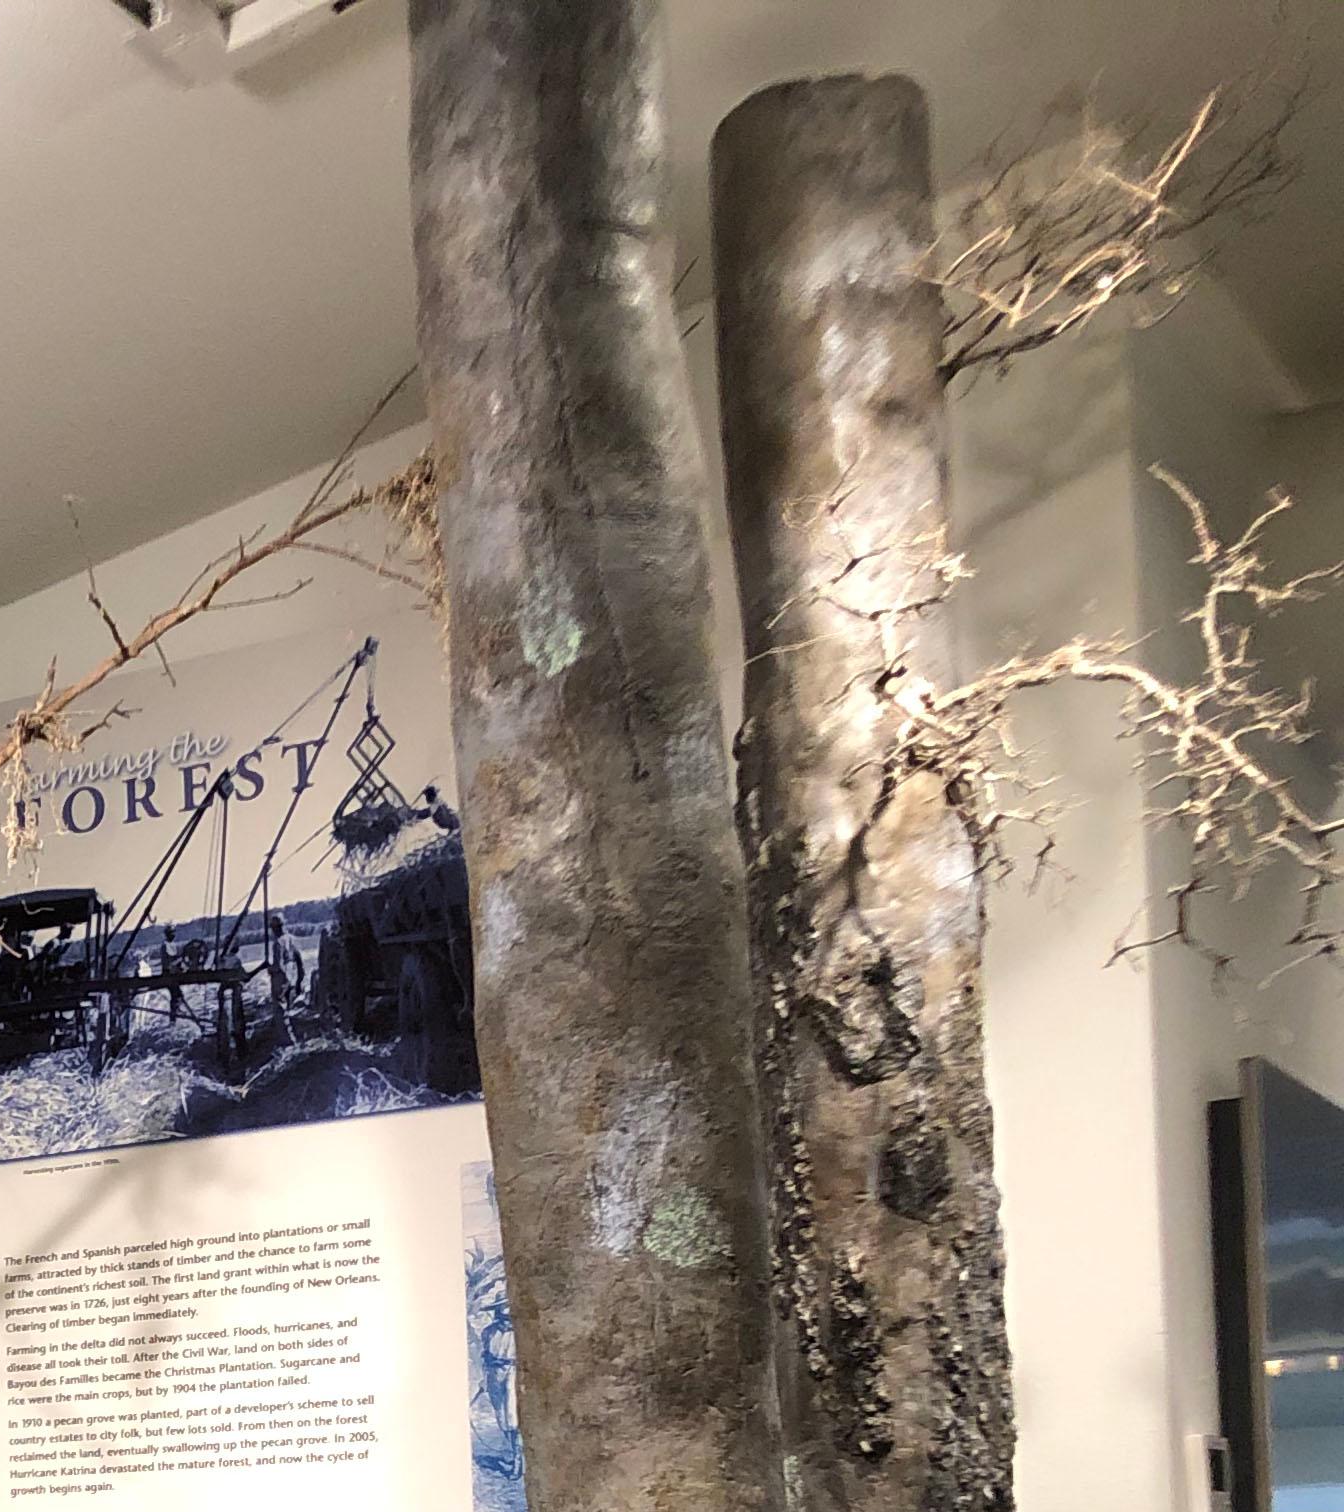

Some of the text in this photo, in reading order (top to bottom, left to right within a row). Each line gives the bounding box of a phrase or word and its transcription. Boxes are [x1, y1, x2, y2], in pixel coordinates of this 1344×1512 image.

[28, 732, 229, 794] arming the
[15, 740, 323, 834] FOREST
[6, 1317, 358, 1356] Farming in the delta did not always succeed. Floods, hurricanes, and
[6, 1363, 42, 1372] disease
[44, 1360, 56, 1369] all
[58, 1358, 81, 1368] took
[83, 1356, 108, 1366] their
[110, 1354, 132, 1363] toll.
[132, 1352, 159, 1362] After
[161, 1350, 179, 1360] the
[181, 1348, 204, 1358] Civil
[206, 1347, 230, 1356] War,
[234, 1344, 258, 1354] land
[277, 1340, 303, 1350] both
[307, 1339, 333, 1348] sides
[336, 1336, 348, 1346] of
[6, 1353, 360, 1390] Bayou des Families became the Christmas Plantation. Sugarcane and
[7, 1375, 309, 1405] rice were the main crops, but by 1904 the plantation failed.
[7, 1420, 18, 1428] In
[21, 1418, 43, 1428] 1910
[53, 1417, 83, 1427] pecan
[85, 1415, 115, 1426] grove
[139, 1409, 182, 1422] planted,
[185, 1408, 207, 1418] part
[210, 1405, 222, 1415] of
[233, 1402, 294, 1413] developer's
[297, 1400, 338, 1409] scheme
[341, 1398, 353, 1406] to
[356, 1395, 374, 1405] sell
[8, 1436, 46, 1445] country
[48, 1434, 84, 1443] estates
[99, 1431, 118, 1441] city
[120, 1428, 142, 1438] folk,
[145, 1428, 163, 1437] but
[165, 1426, 185, 1435] few
[187, 1425, 207, 1434] lots
[210, 1422, 234, 1432] sold.
[237, 1422, 265, 1430] From
[268, 1420, 293, 1429] then
[314, 1416, 332, 1426] the
[335, 1415, 368, 1424] forest
[9, 1452, 57, 1462] reclaimed
[59, 1450, 76, 1459] the
[78, 1448, 104, 1458] land,
[106, 1445, 159, 1456] eventually
[162, 1443, 220, 1453] swallowing
[223, 1442, 237, 1451] up
[239, 1439, 257, 1448] the
[260, 1439, 293, 1450] pecan
[334, 1434, 345, 1443] In
[348, 1431, 378, 1442] 2005,
